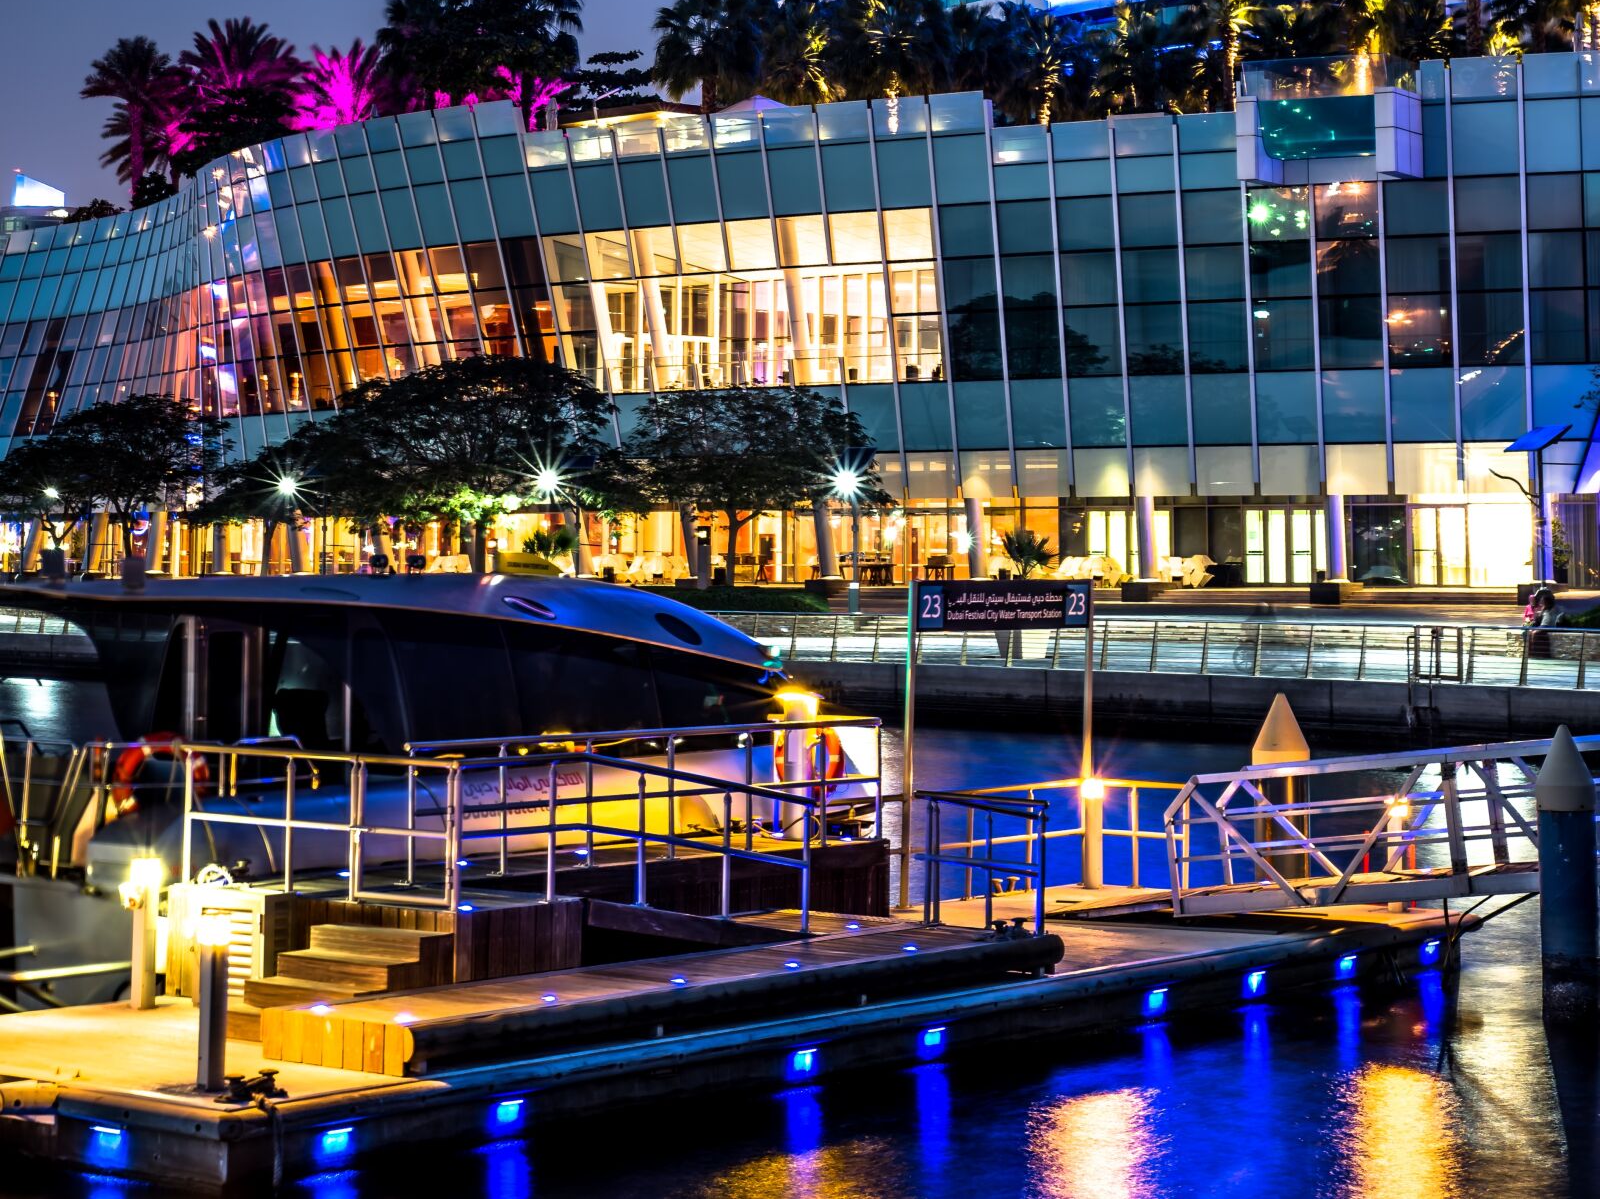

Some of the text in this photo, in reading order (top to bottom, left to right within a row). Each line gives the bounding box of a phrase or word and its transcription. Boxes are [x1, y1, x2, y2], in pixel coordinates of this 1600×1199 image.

[967, 593, 985, 605] للنقل
[986, 593, 1004, 607] سيتي
[1005, 593, 1031, 605] فستيفال
[1032, 595, 1045, 606] دبي
[1045, 592, 1063, 602] محطة
[1068, 593, 1085, 615] 23
[922, 594, 941, 618] 23
[947, 608, 1062, 622] Dubai Festival City Water Transport Station
[464, 782, 493, 799] دبي
